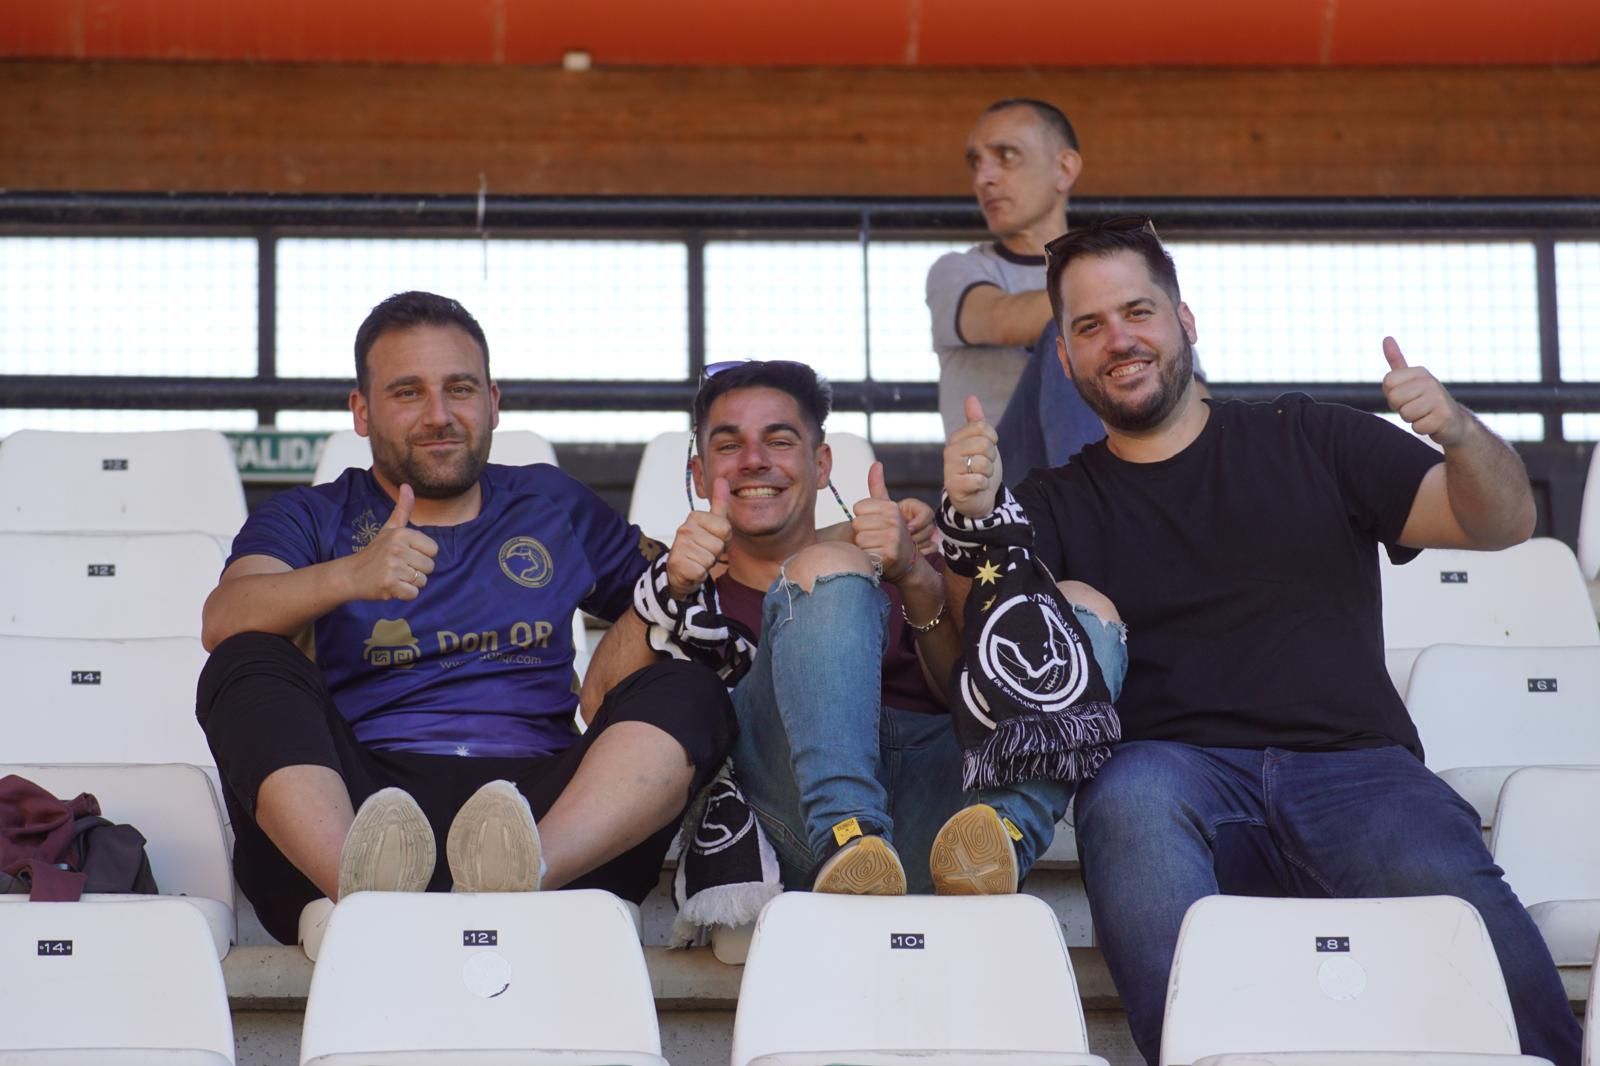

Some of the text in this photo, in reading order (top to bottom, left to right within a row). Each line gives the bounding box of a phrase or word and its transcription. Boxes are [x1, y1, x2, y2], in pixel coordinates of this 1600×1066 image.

[94, 566, 109, 575] 12
[1449, 572, 1460, 581] 4
[1028, 593, 1080, 642] VNITAS
[437, 630, 498, 654] Don
[76, 672, 95, 682] 14
[1537, 680, 1547, 690] 6
[470, 932, 489, 944] 12
[897, 936, 917, 947] 10
[44, 943, 64, 953] 14
[1327, 939, 1338, 950] 8
